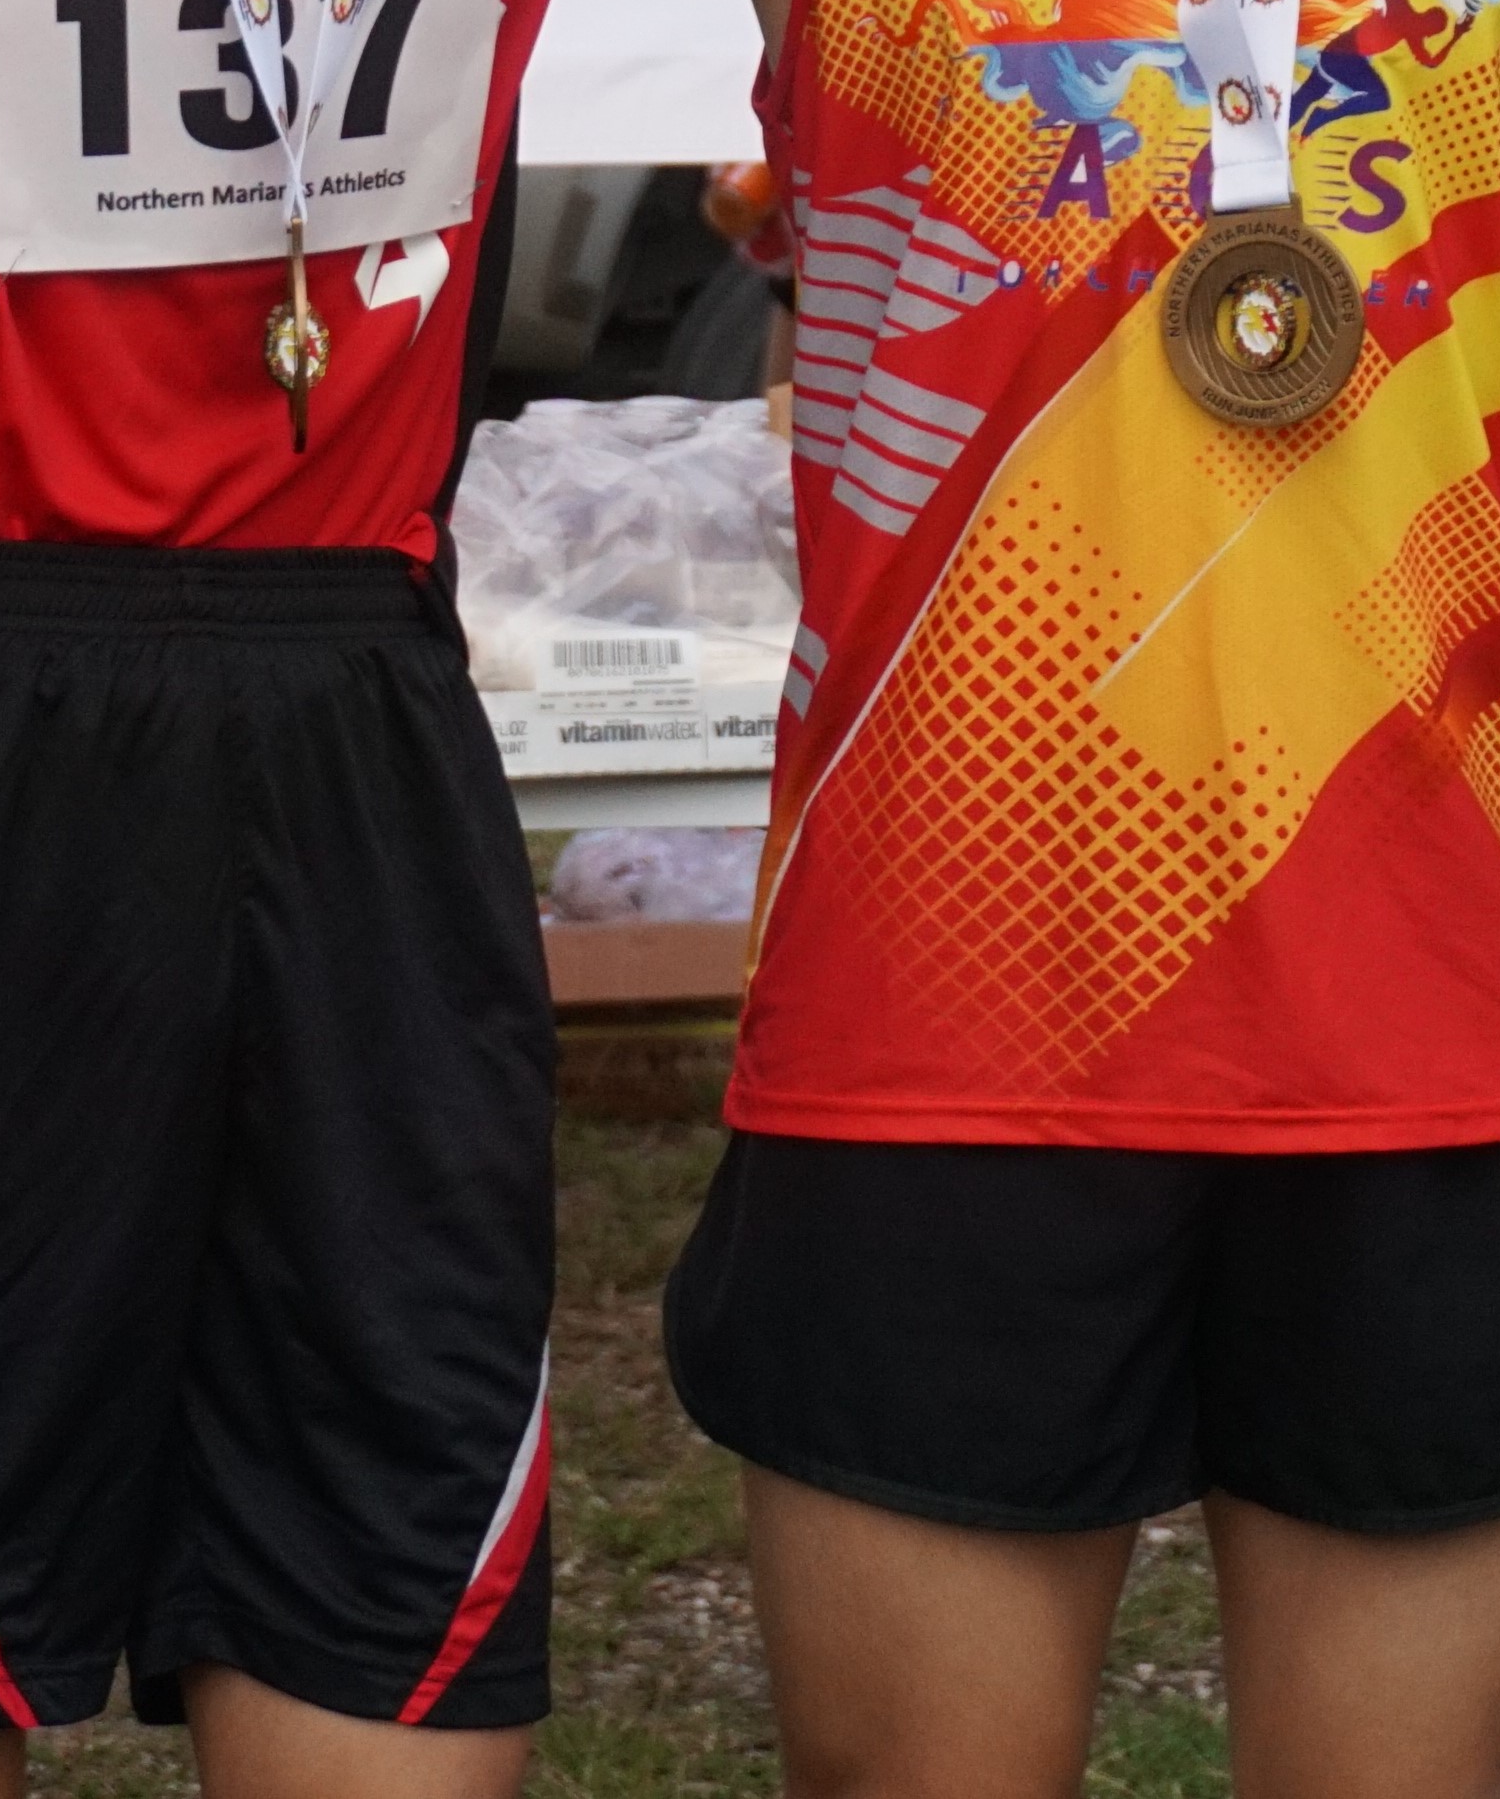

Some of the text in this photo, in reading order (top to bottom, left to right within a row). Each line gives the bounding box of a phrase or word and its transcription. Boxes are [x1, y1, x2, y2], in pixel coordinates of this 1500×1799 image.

[97, 187, 204, 212] Northern
[320, 167, 406, 197] Athletics
[1211, 222, 1301, 246] MARIANAS
